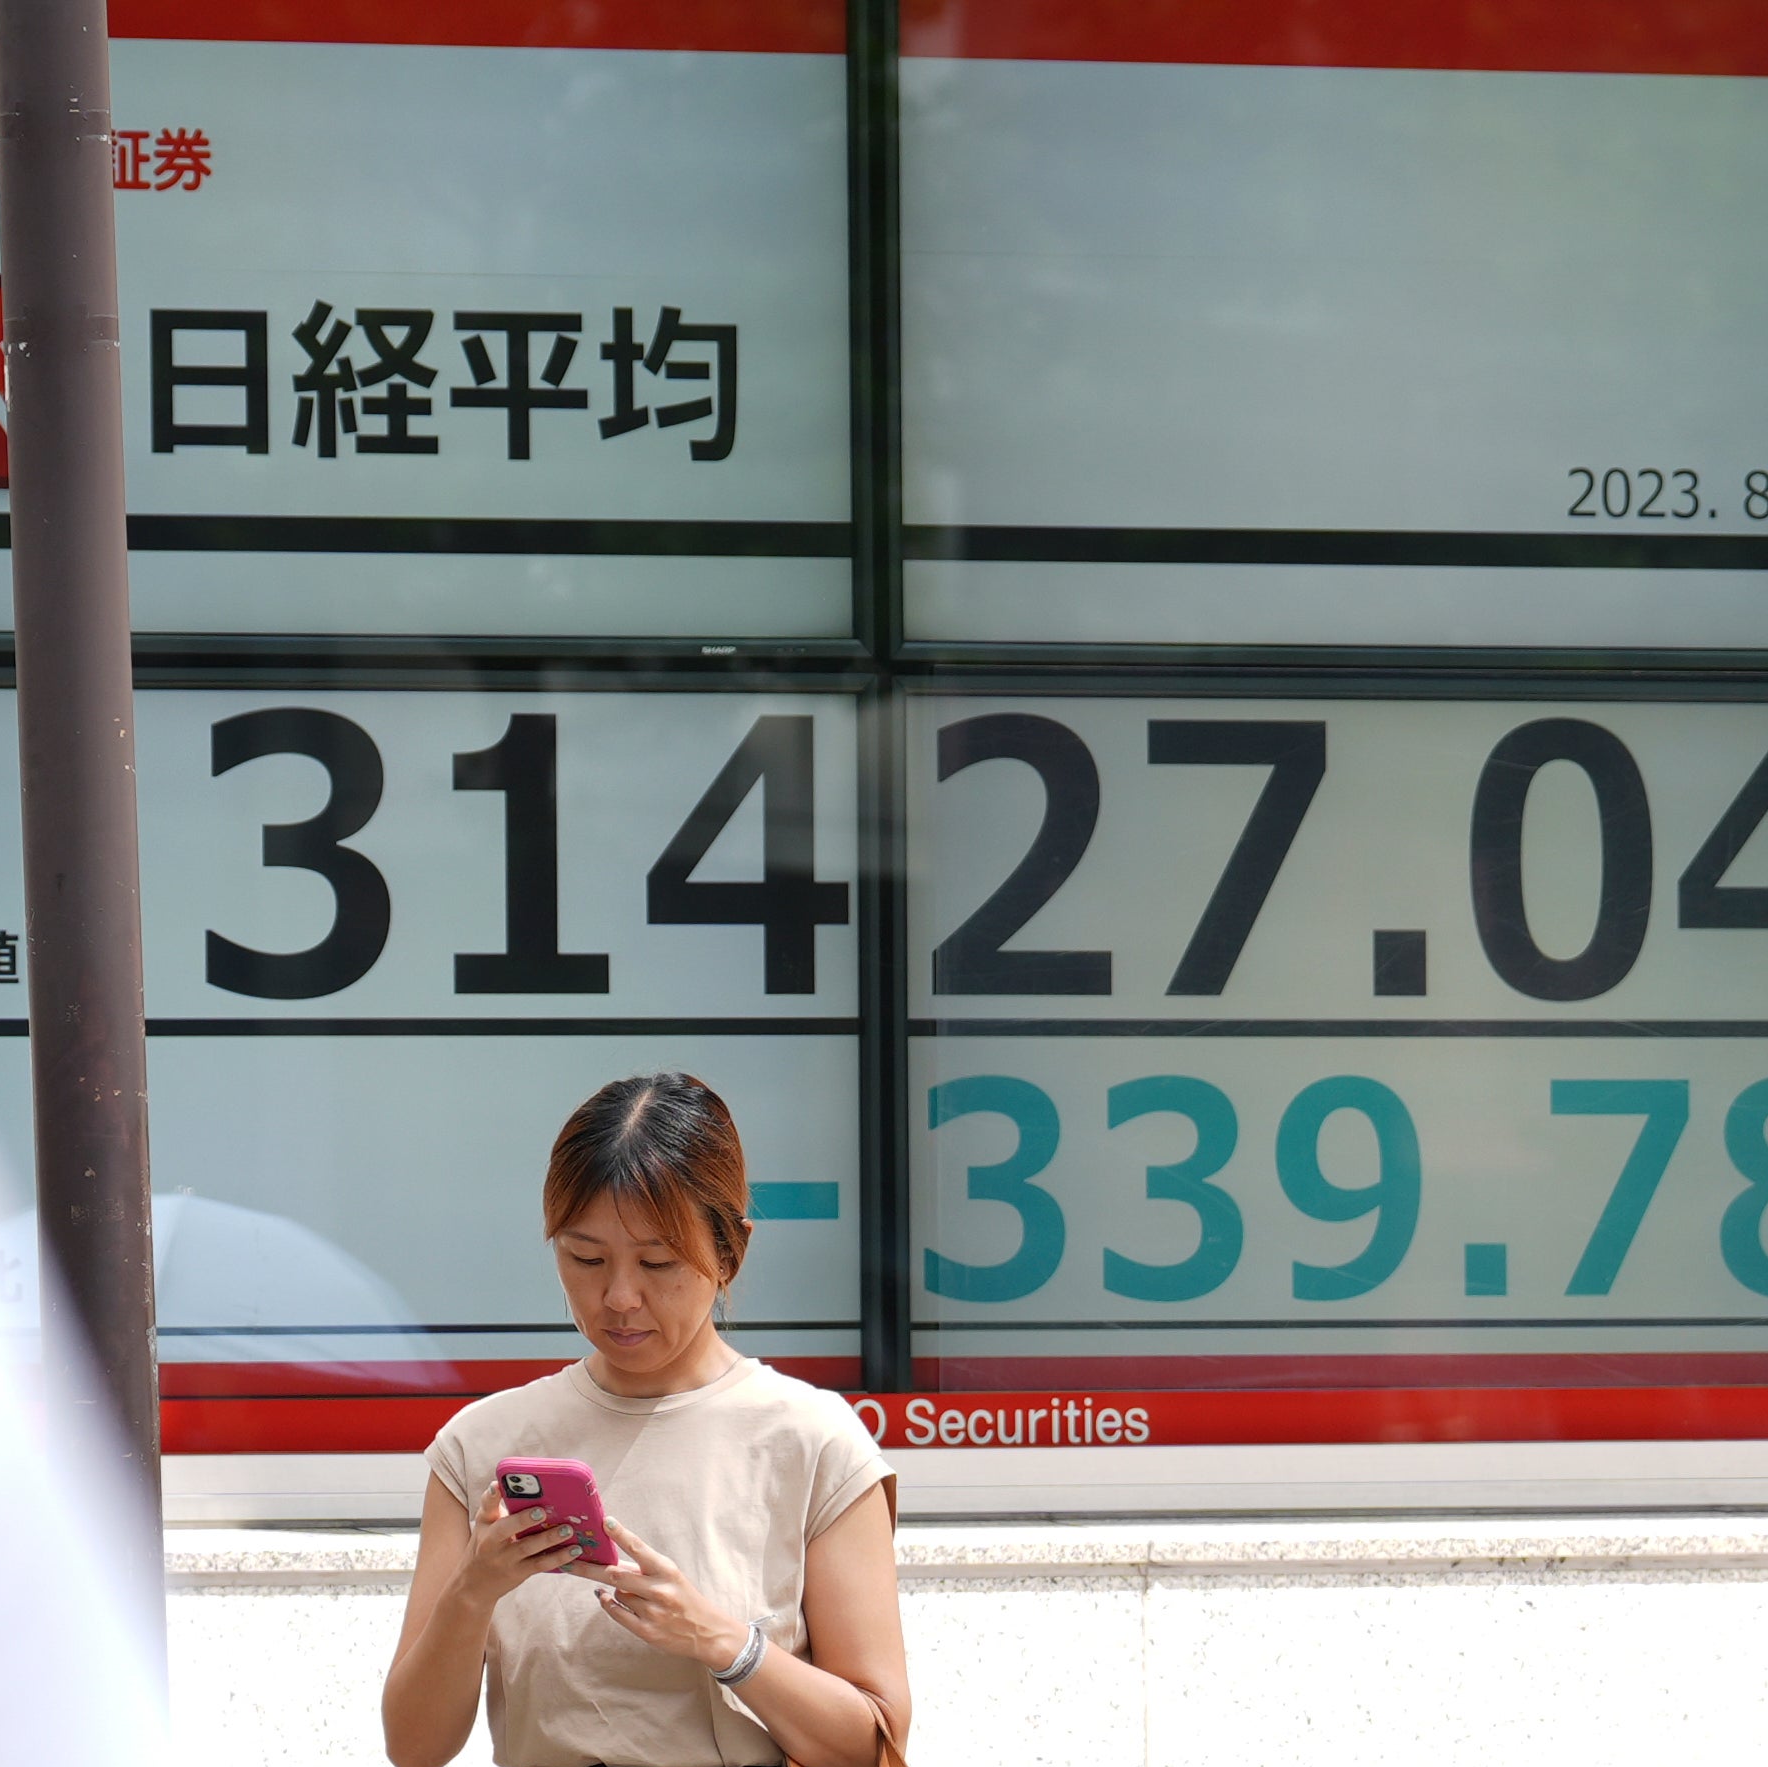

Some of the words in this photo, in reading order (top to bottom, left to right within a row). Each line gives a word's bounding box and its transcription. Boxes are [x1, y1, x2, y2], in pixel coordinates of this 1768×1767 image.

[149, 300, 739, 462] 日経平均
[904, 1396, 1150, 1446] Securities
